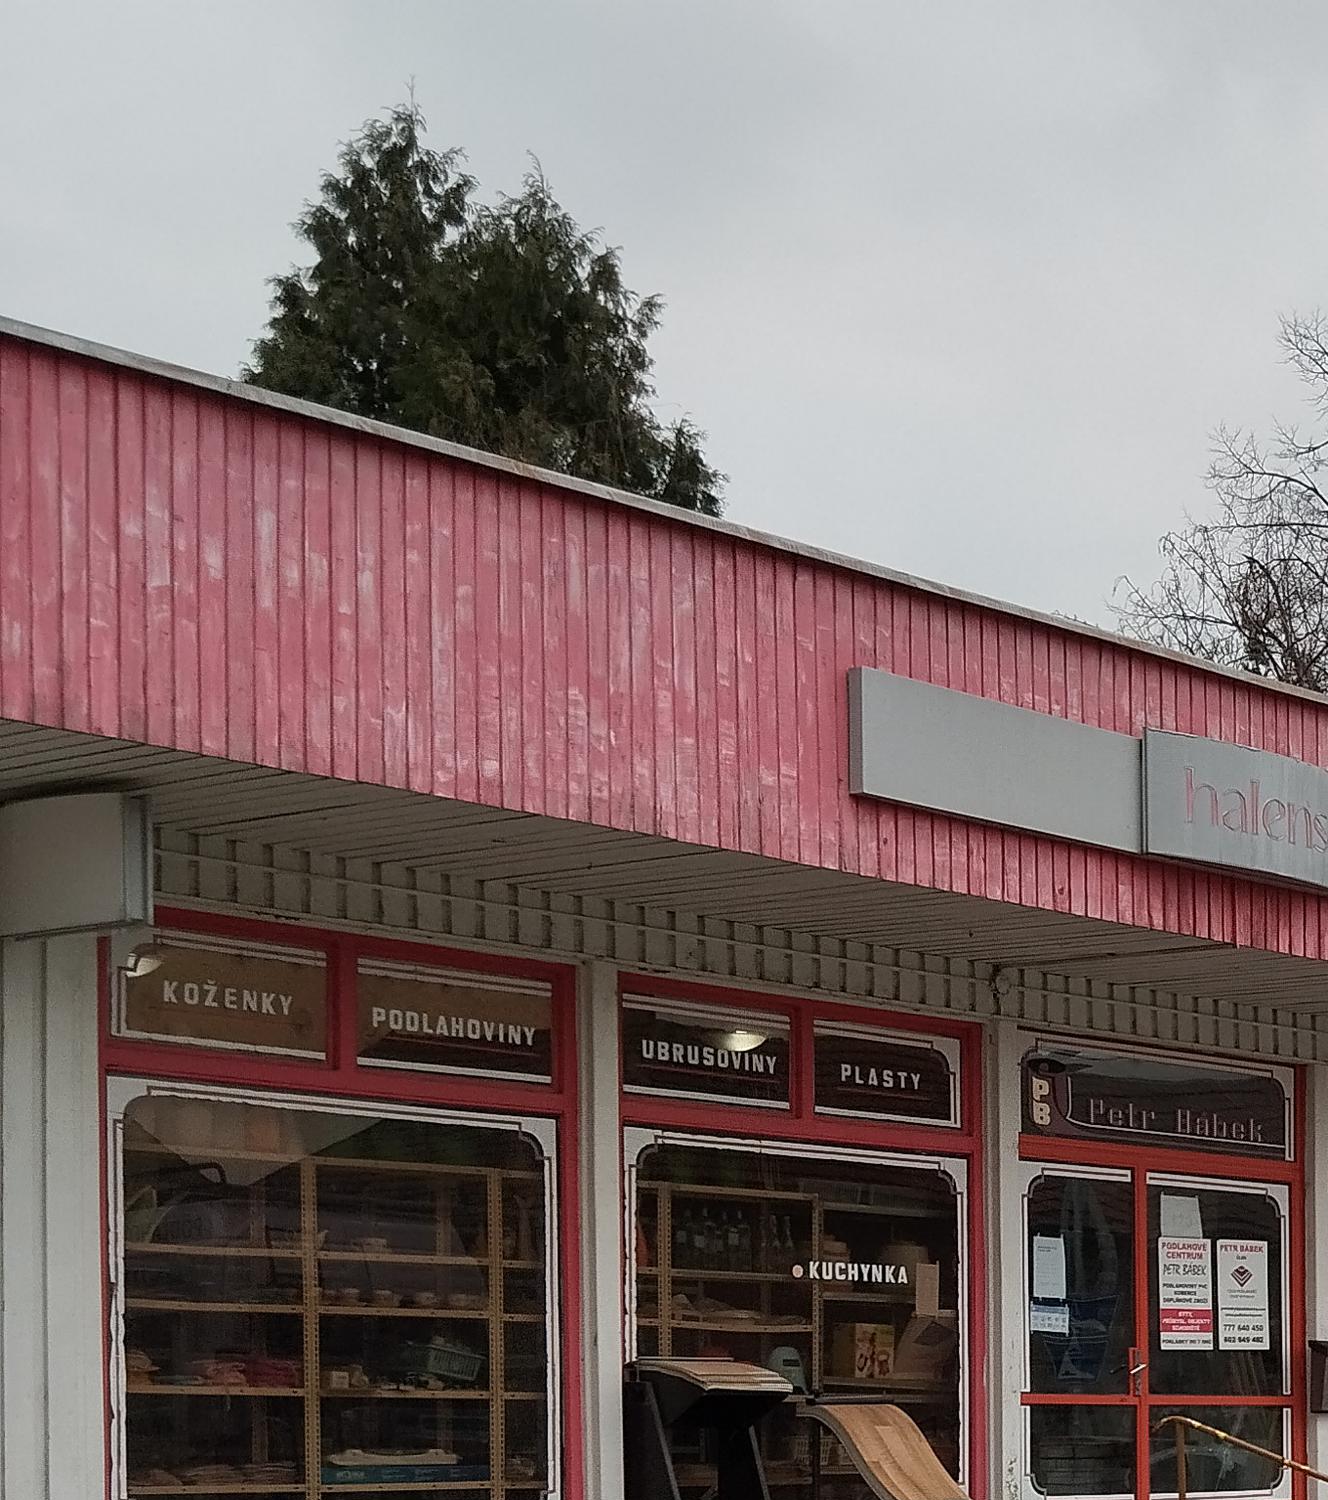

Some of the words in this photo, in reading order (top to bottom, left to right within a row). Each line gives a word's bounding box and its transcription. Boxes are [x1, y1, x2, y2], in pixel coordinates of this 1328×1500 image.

[163, 979, 293, 1016] KOŽENKY
[372, 1006, 536, 1046] PODLAHOVINY
[641, 1039, 777, 1075] UBRUSOVINY
[841, 1063, 921, 1091] PLASTY
[1090, 1099, 1155, 1130] Petr
[1161, 1242, 1207, 1252] PODLAHOVÉ
[1166, 1251, 1203, 1260] CENTRUM
[1220, 1244, 1238, 1252] PETR
[1240, 1244, 1264, 1253] BÁBEK
[809, 1261, 908, 1284] KUCHYNKA
[1163, 1263, 1181, 1276] PETR
[1182, 1261, 1207, 1276] BÁBEK
